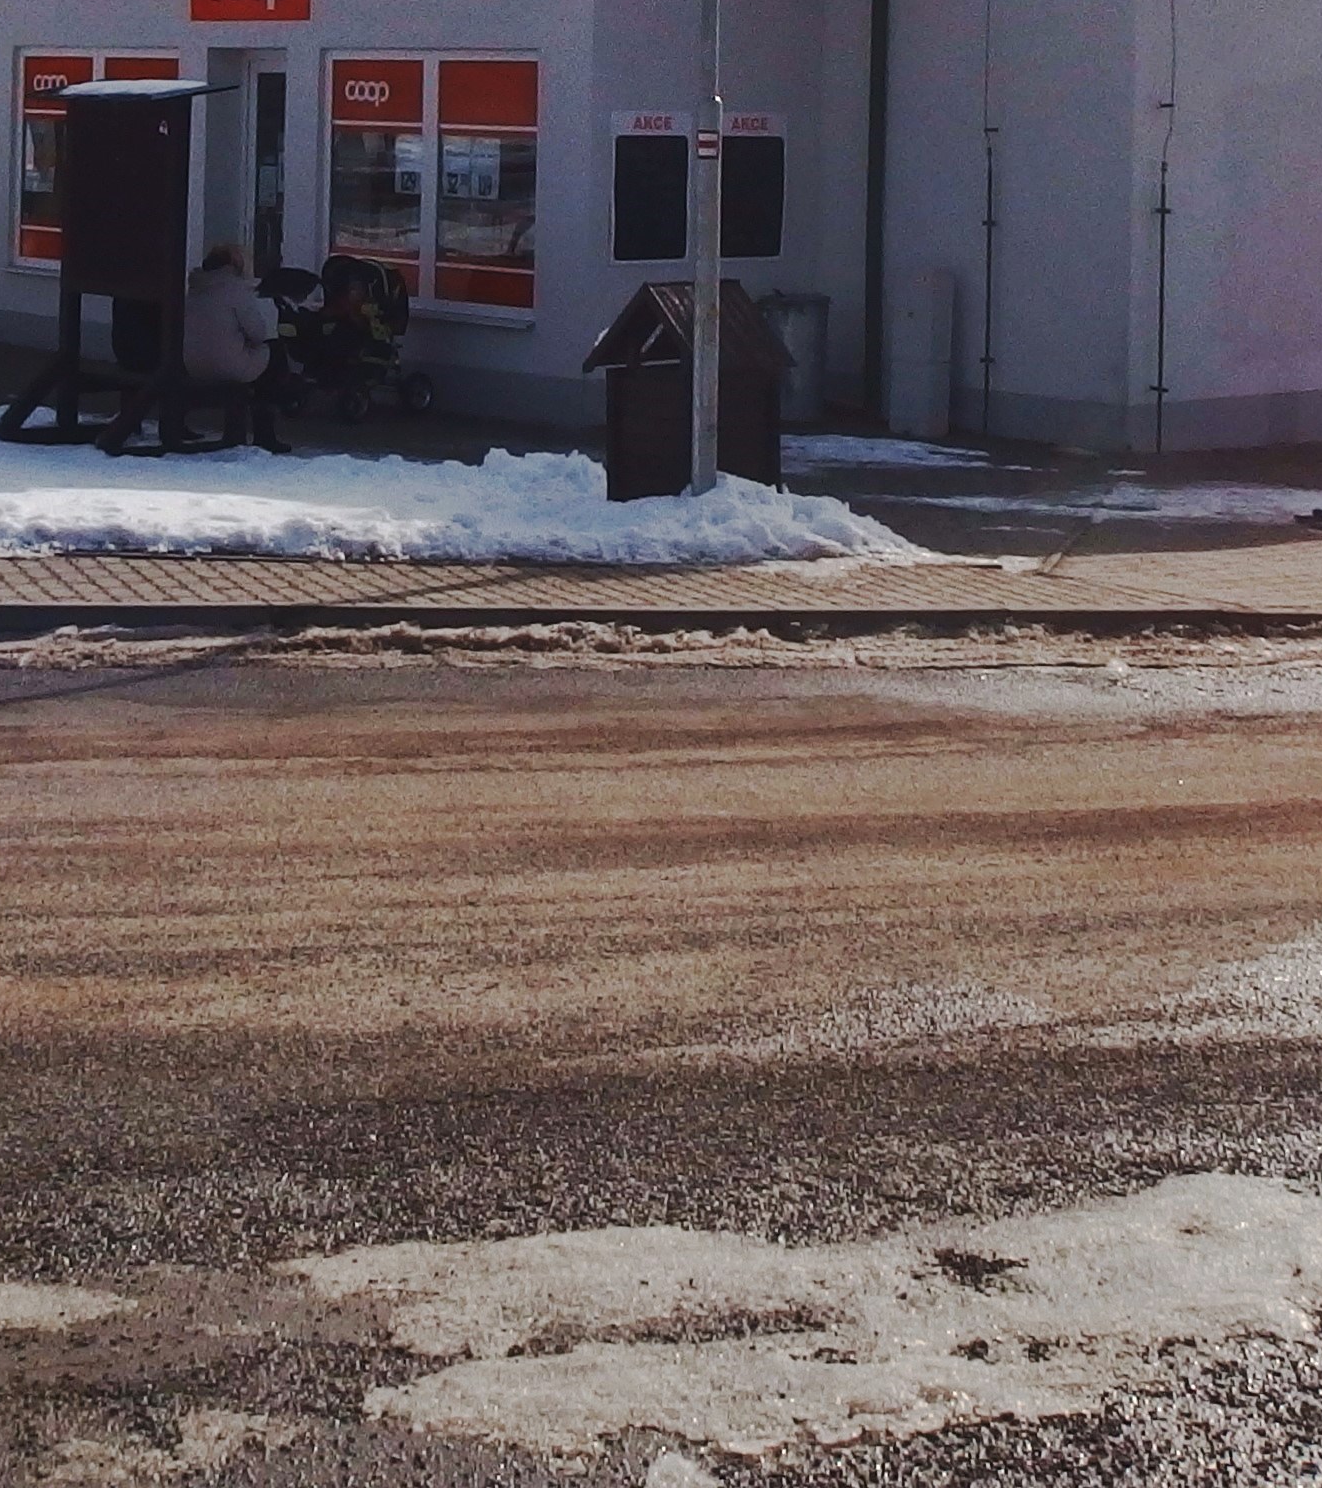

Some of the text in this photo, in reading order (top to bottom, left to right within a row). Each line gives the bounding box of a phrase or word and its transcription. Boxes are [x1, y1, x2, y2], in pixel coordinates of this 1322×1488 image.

[344, 80, 389, 107] coop
[633, 116, 674, 131] AKCE
[731, 117, 769, 131] AKCE
